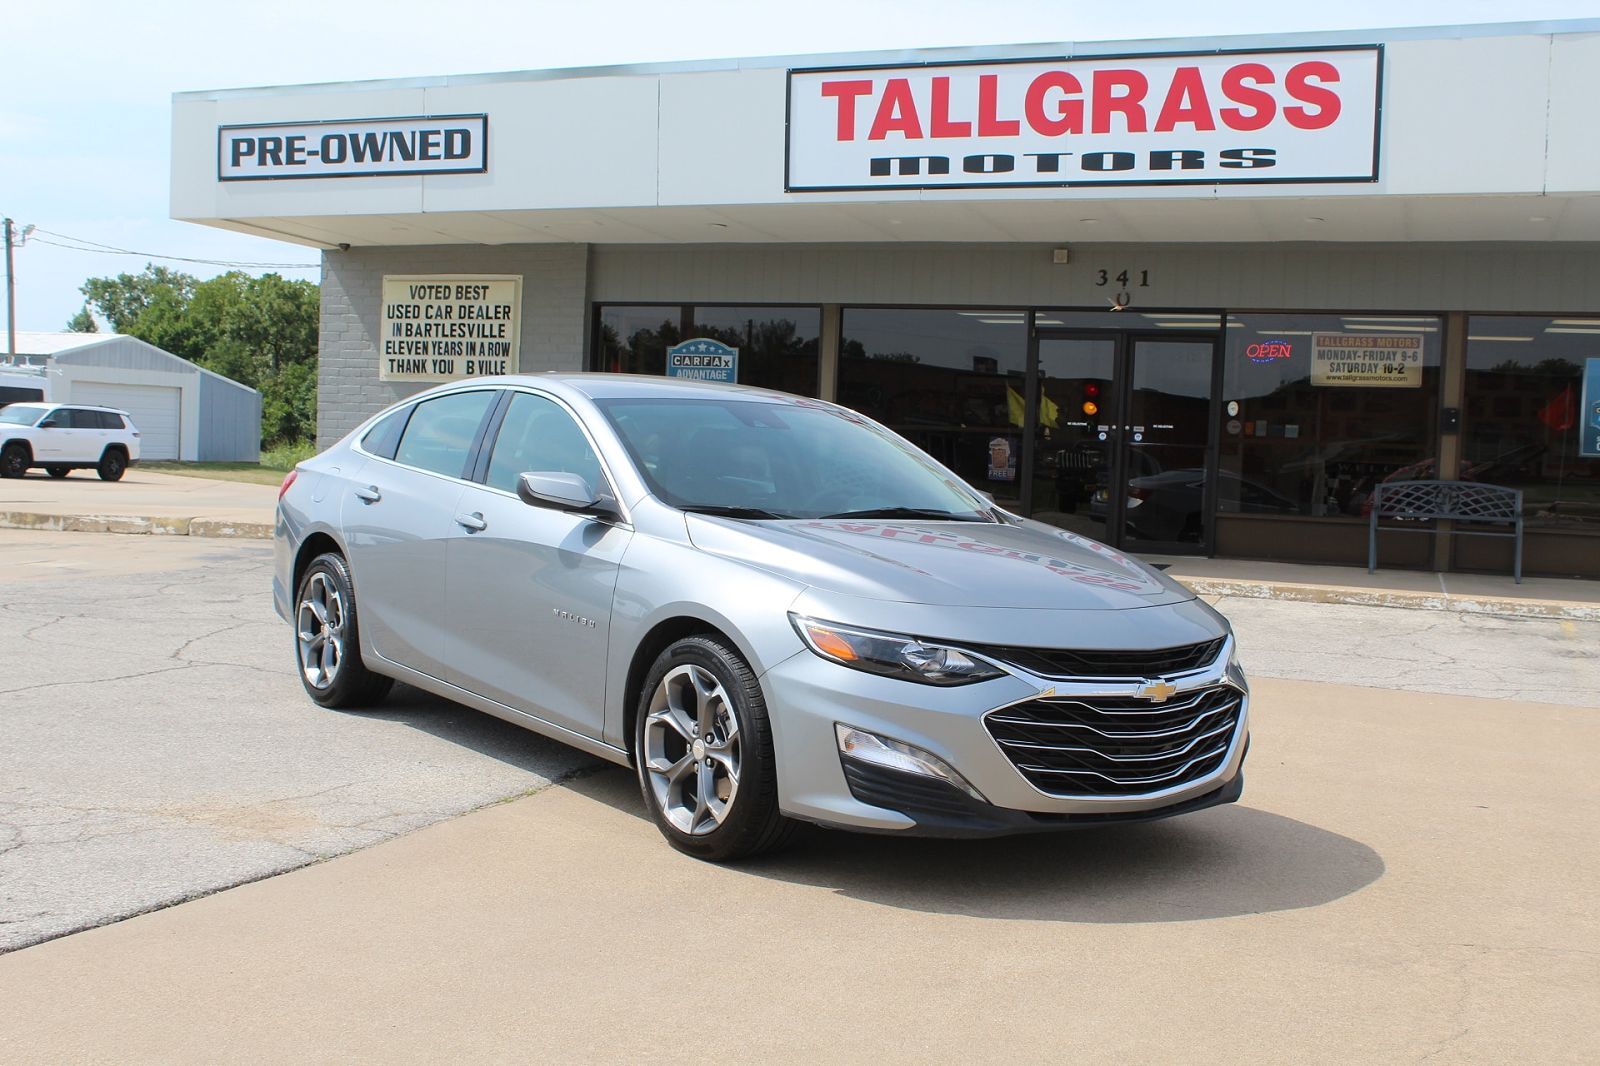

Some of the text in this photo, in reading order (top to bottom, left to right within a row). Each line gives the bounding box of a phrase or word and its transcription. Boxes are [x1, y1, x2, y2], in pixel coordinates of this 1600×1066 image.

[821, 60, 1342, 141] TALLGRASS
[231, 128, 471, 167] PRE-OWNED
[870, 148, 1277, 176] MOTORS
[409, 285, 490, 300] VOTED BEST
[387, 304, 511, 320] USED CAR DEALER
[392, 323, 506, 338] IN BARTLESVILLE
[385, 341, 511, 357] ELEVEN YEARS IN A ROW
[1318, 336, 1419, 348] TALLGRASS MOTORS
[1246, 344, 1292, 358] OPEN
[1401, 351, 1418, 362] 9-6
[389, 359, 427, 374] THANK
[432, 359, 454, 374] YOU
[674, 356, 730, 367] CARFAX
[1329, 362, 1405, 374] SATURDAY 10-2
[676, 369, 728, 380] ADVANTAGE
[1326, 374, 1408, 382] www.tallgrassmotors.com
